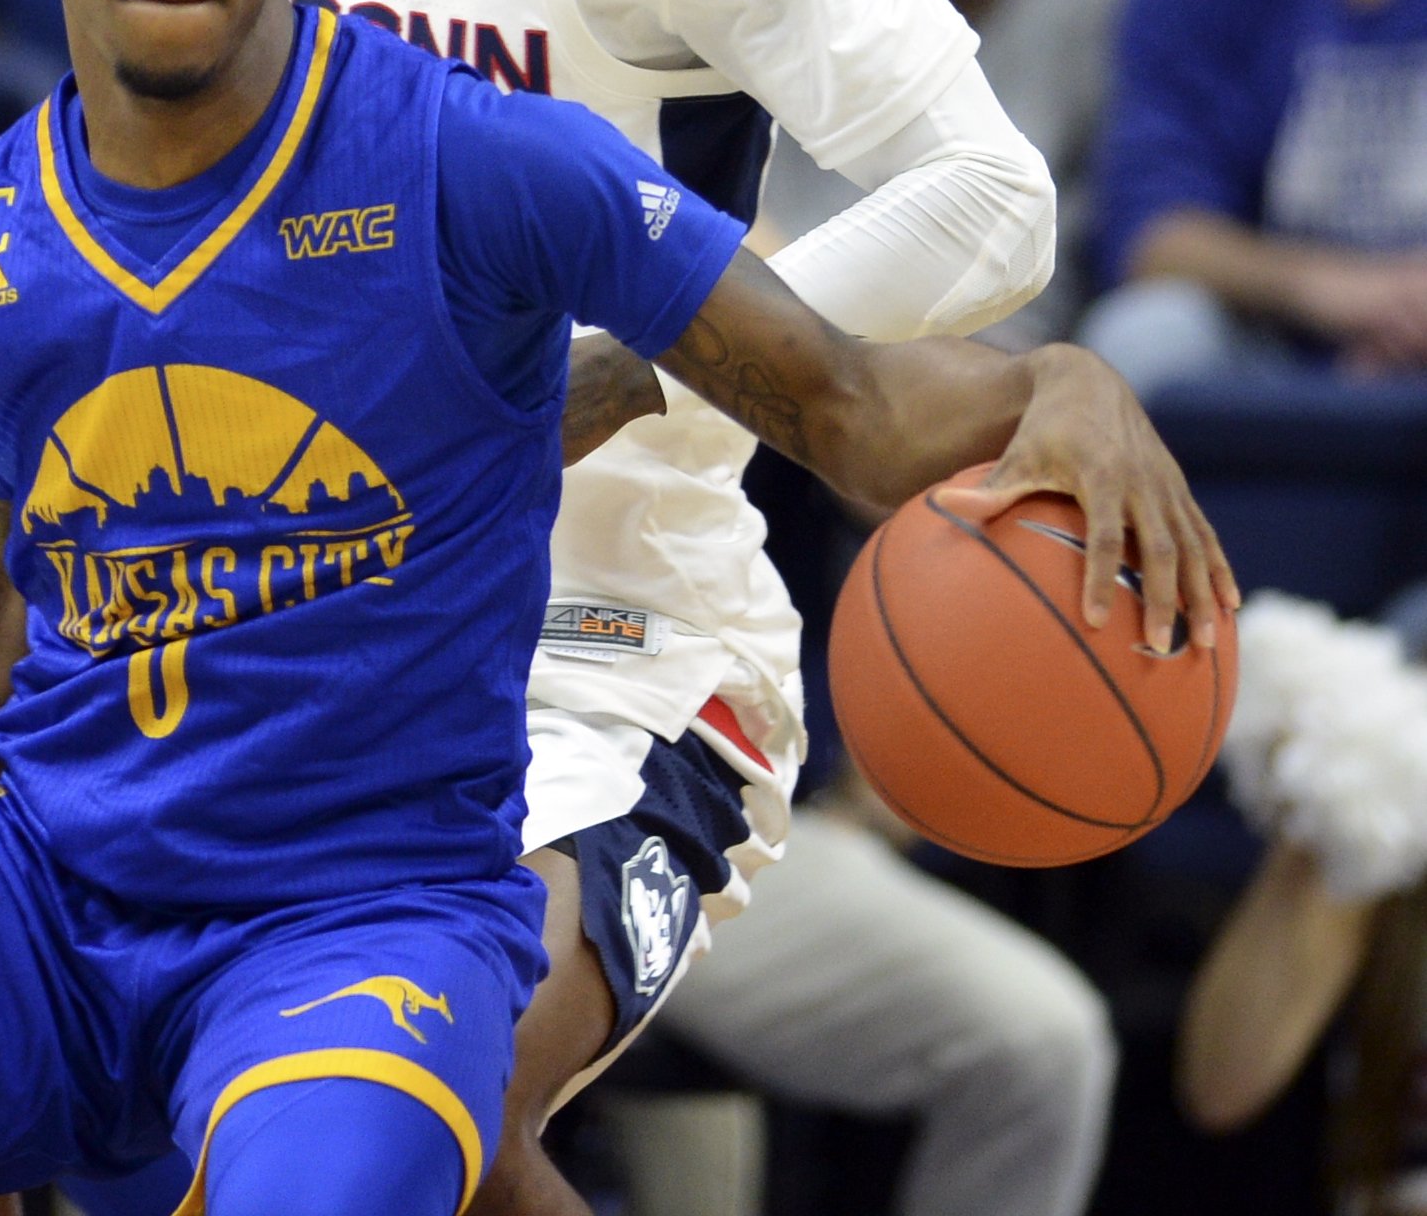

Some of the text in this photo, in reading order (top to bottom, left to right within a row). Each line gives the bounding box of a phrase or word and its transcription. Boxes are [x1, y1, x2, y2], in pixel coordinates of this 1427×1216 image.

[278, 203, 395, 260] WAC
[647, 187, 681, 241] adidas
[581, 607, 646, 626] NIKE
